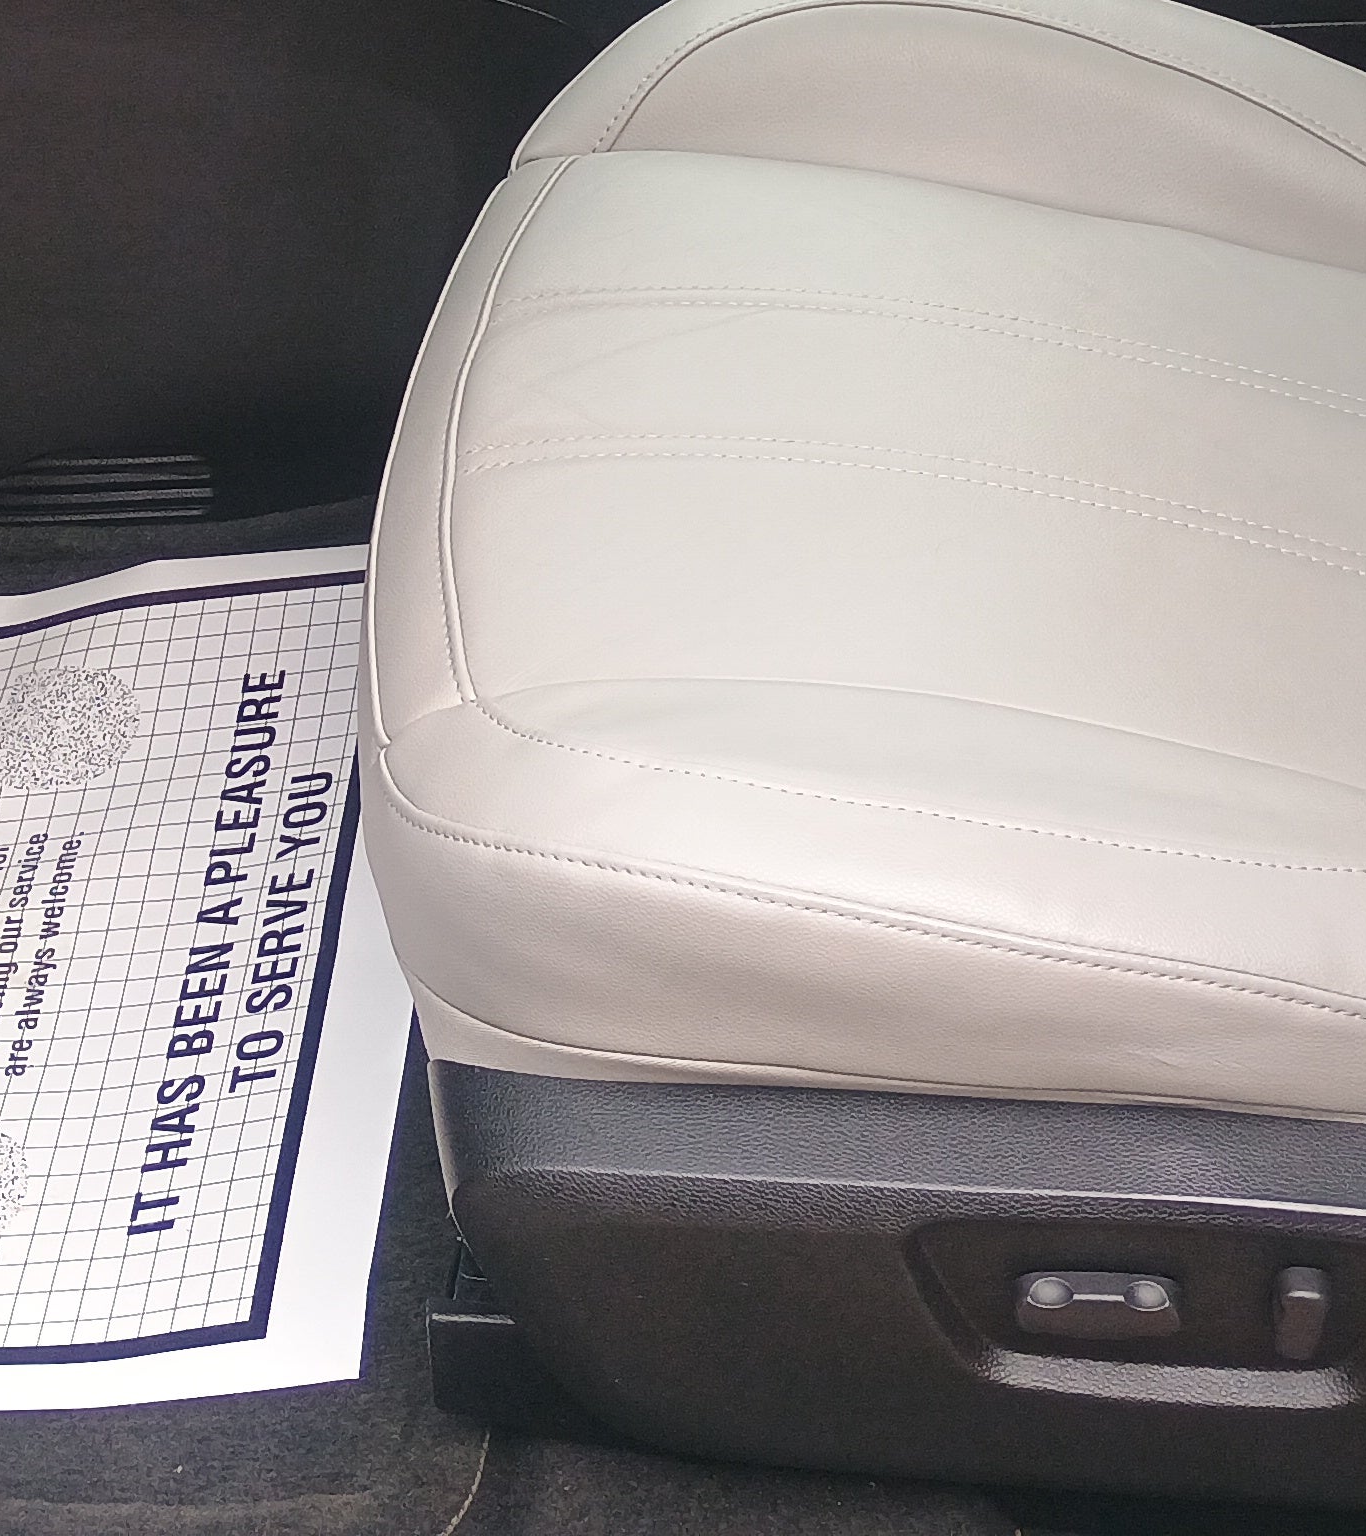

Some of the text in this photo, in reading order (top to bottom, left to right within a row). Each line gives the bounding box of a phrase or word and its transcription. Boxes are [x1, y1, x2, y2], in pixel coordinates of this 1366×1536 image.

[4, 831, 85, 1077] are always welcome.
[9, 833, 49, 908] service
[127, 669, 286, 1236] IT HAS BEEN A PLEASURE
[228, 771, 333, 1093] TO SERVE YOU
